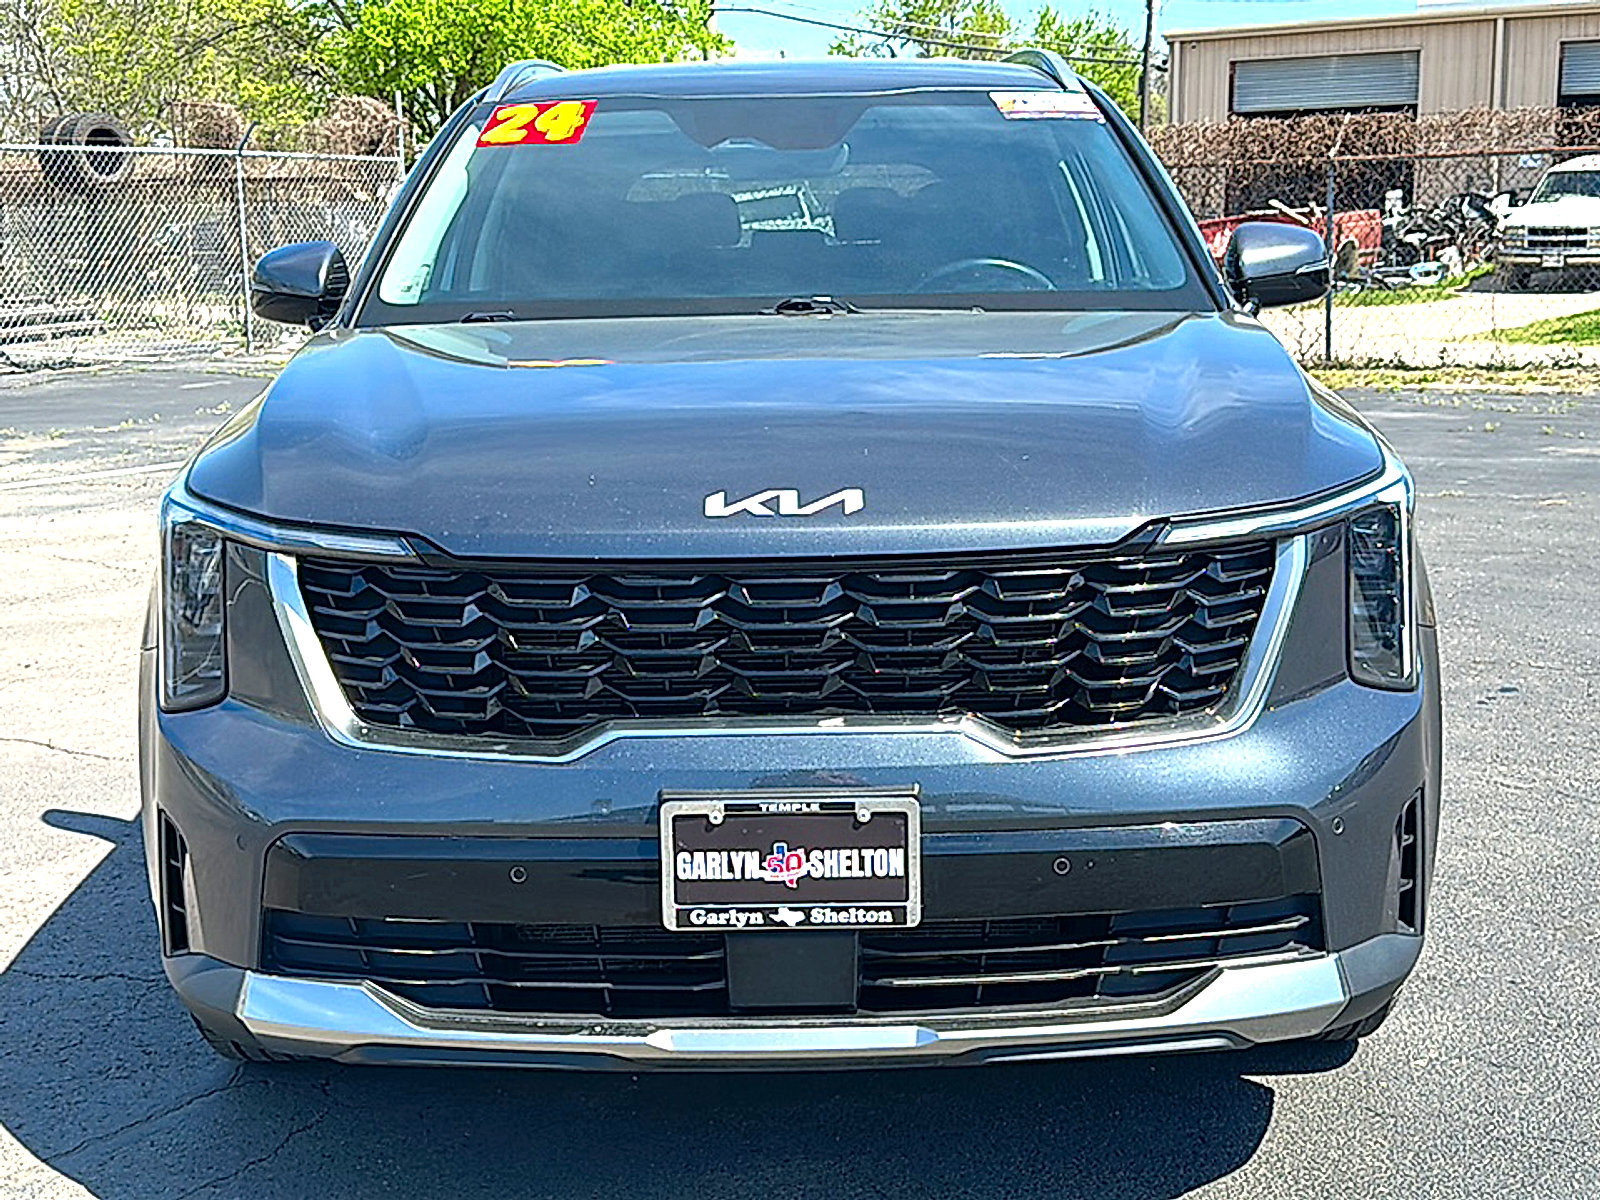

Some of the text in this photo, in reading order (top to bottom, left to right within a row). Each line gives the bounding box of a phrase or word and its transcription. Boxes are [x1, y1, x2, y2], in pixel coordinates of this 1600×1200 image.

[480, 101, 585, 143] 24
[704, 489, 865, 516] KIA
[759, 803, 820, 812] TEMPLE
[676, 851, 761, 880] GARLYN
[808, 848, 905, 879] SHELTON
[689, 907, 893, 928] Garlyn Shelton
